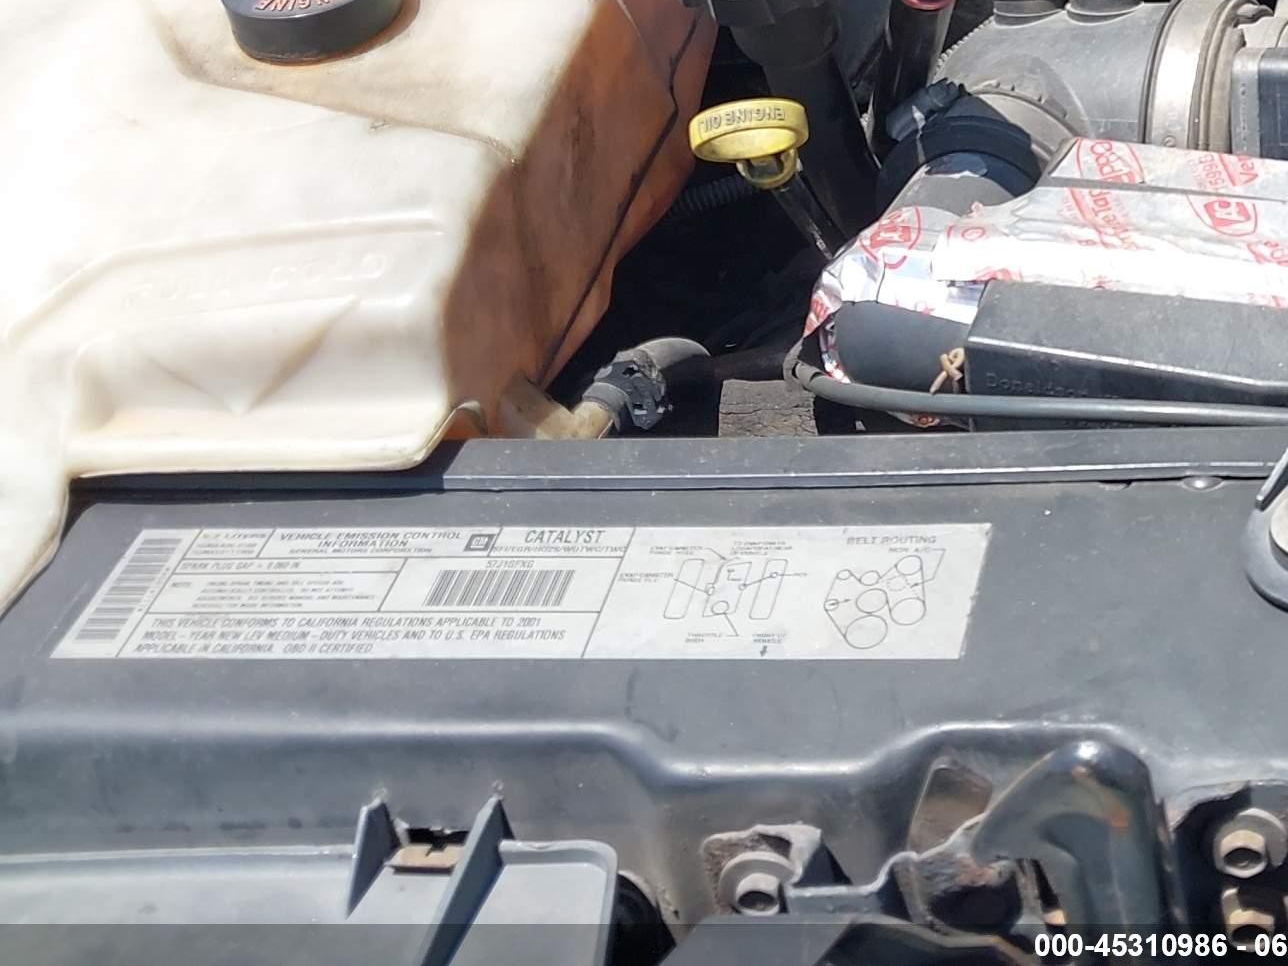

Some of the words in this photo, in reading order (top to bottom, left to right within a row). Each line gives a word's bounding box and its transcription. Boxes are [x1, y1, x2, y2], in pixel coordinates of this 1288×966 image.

[724, 107, 786, 127] ENGINE
[279, 532, 331, 541] VEHICLE
[336, 531, 400, 540] EMISSION
[402, 531, 463, 540] CONTROL
[523, 529, 606, 544] CATALYST
[846, 536, 880, 545] BELT
[880, 535, 937, 544] ROUTING
[317, 539, 409, 548] INFORMATION
[151, 617, 177, 627] THIS
[177, 617, 219, 627] VEHICLE
[221, 617, 279, 627] CONFORMS
[281, 617, 297, 627] TO
[297, 617, 359, 627] CALIFORNIA
[360, 617, 433, 627] REGULATIONS
[434, 616, 497, 627] APPLICABLE
[499, 616, 515, 627] TO
[516, 616, 542, 627] 2001
[188, 630, 218, 641] YEAR
[218, 630, 246, 641] NEW
[267, 630, 310, 641] MEDIUM
[319, 630, 347, 641] DUTY
[350, 630, 400, 640] VEHICLES
[400, 630, 426, 640] AND
[428, 630, 443, 640] TO
[444, 630, 465, 640] U.S.
[469, 629, 492, 640] EPA
[493, 629, 567, 640] REGULATIONS
[134, 643, 196, 653] APPLICABLE
[211, 643, 274, 653] CALIFORNIA
[282, 642, 306, 653] OBD
[319, 642, 374, 653] CERTIFIED
